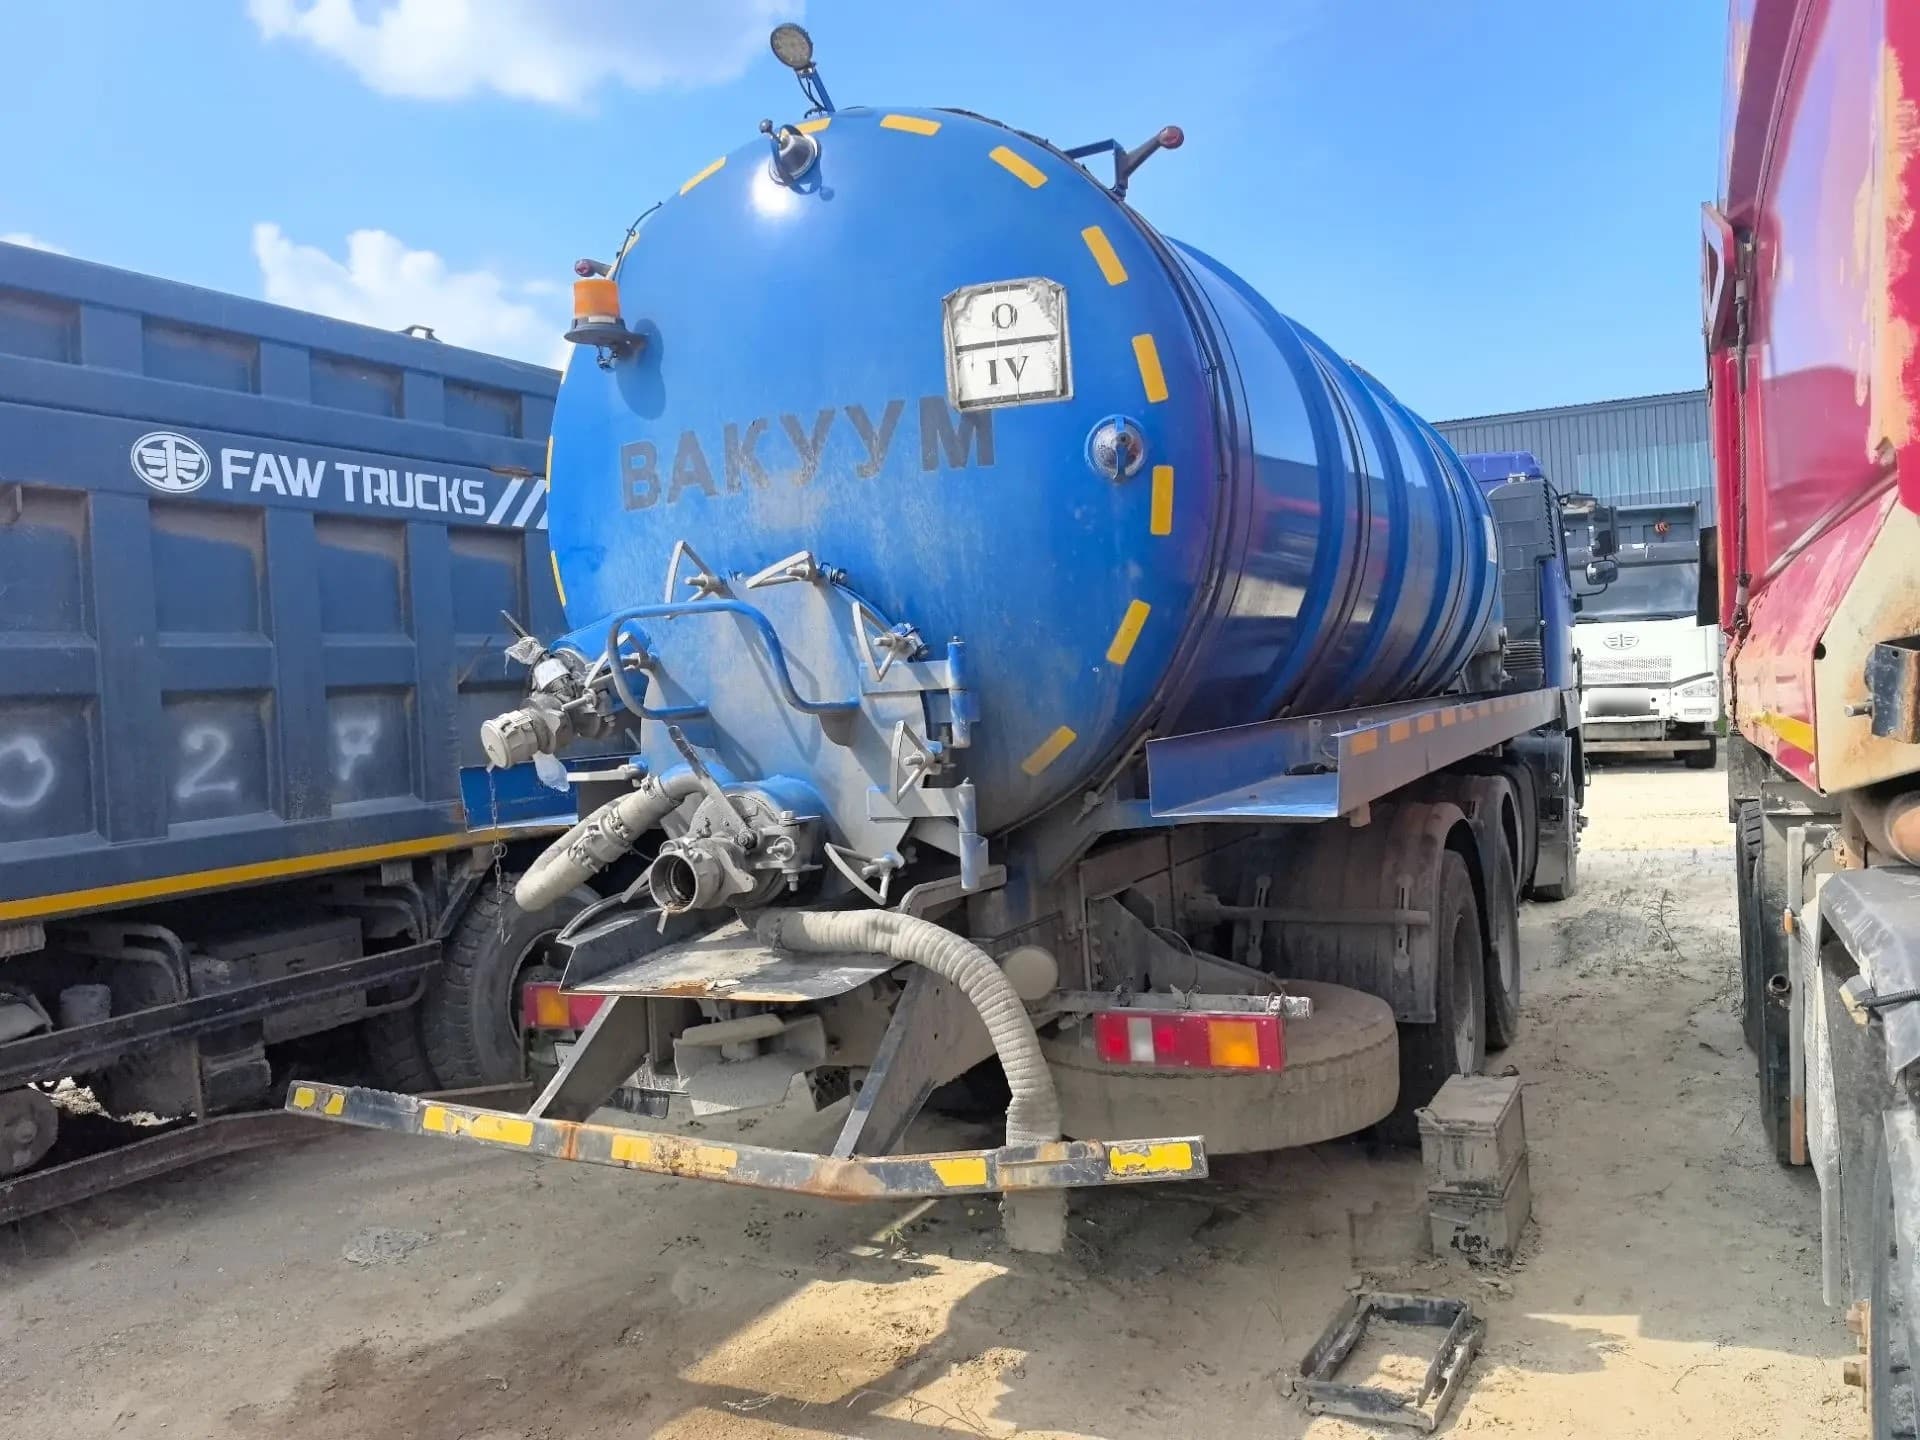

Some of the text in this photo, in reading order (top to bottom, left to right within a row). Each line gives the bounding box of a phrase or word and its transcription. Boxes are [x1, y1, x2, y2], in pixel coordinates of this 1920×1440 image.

[986, 355, 1029, 385] IV
[221, 447, 486, 517] FAW TRUCKS
[620, 395, 996, 512] ВАКУУМ
[176, 724, 240, 800] 2
